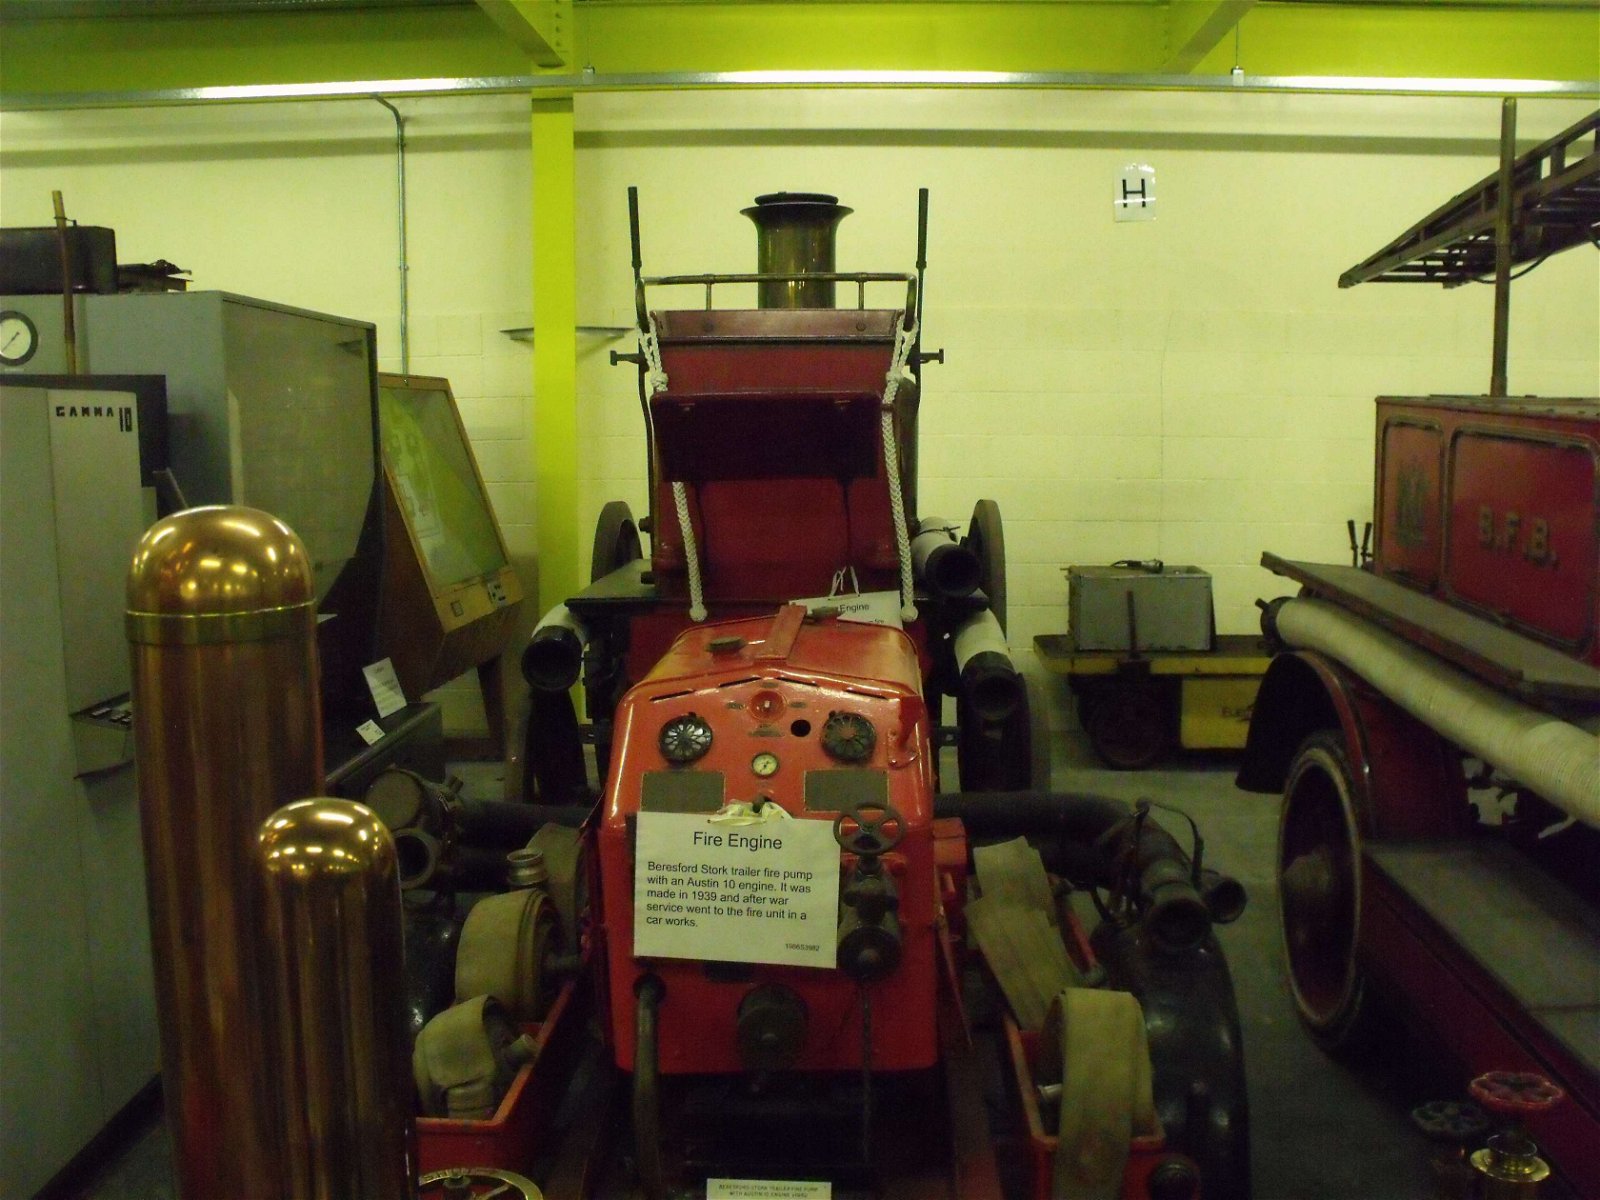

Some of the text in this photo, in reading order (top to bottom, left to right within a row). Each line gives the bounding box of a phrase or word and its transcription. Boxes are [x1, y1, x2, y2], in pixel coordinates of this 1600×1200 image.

[1122, 178, 1146, 208] H
[56, 406, 133, 432] GAMMA 10
[840, 602, 870, 614] Engine
[693, 831, 782, 851] Fire Engine
[647, 861, 813, 881] Beresford Stork trailer fire pump
[647, 875, 811, 894] with an Austin 10 engine. It was
[647, 888, 789, 906] made in 1939 and after war
[646, 902, 807, 921] service went to the fire unit in a
[646, 916, 698, 927] car works.
